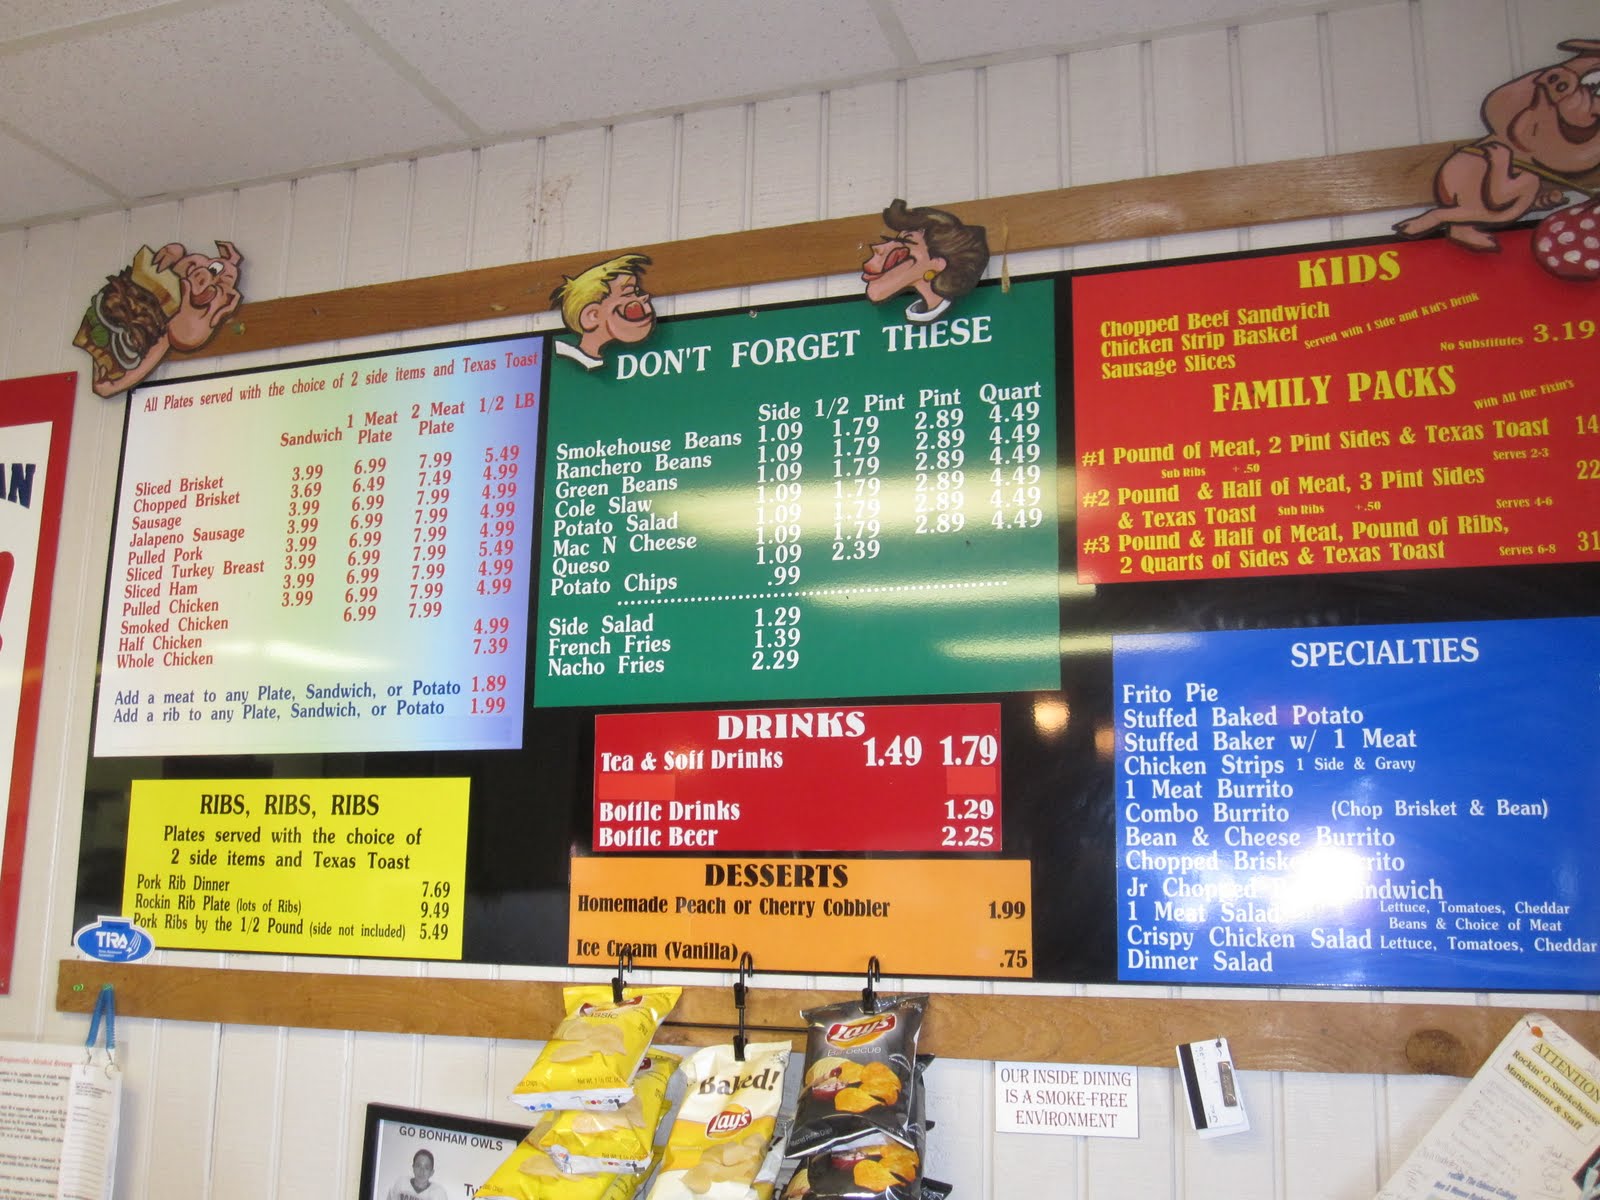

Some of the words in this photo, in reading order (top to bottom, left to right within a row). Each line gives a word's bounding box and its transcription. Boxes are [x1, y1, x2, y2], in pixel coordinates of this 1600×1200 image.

[1297, 249, 1400, 288] KIDS
[1100, 315, 1179, 340] Chopped
[1187, 310, 1229, 329] Beef
[1237, 301, 1330, 325] Sandwich
[1304, 332, 1338, 349] Served
[1341, 326, 1363, 338] with
[1366, 323, 1372, 331] 1
[1374, 317, 1396, 329] Side
[1399, 309, 1418, 322] and
[1421, 302, 1447, 316] Kid's
[1450, 293, 1479, 307] Drink
[1534, 320, 1595, 343] 3.19
[616, 345, 711, 380] DON'T
[731, 330, 860, 368] FORGET
[882, 316, 992, 352] THESE
[1101, 335, 1173, 358] Chicken
[1181, 332, 1225, 353] Strip
[1233, 323, 1297, 346] Basket
[1440, 342, 1455, 351] No
[1458, 337, 1524, 349] Substitutes
[1102, 358, 1176, 379] Sausage
[1185, 354, 1236, 372] Slices
[144, 397, 158, 412] All
[164, 395, 193, 410] Plates
[200, 387, 233, 405] served
[240, 384, 261, 400] with
[268, 382, 285, 397] the
[292, 377, 326, 394] choice
[332, 372, 344, 389] of
[351, 372, 358, 387] 2
[366, 368, 388, 385] side
[395, 367, 426, 381] items
[433, 359, 455, 377] and
[463, 357, 496, 373] Texas
[505, 352, 537, 368] Toast
[979, 381, 1041, 404] Quart
[1213, 375, 1331, 412] FAMILY
[1347, 365, 1456, 402] PACKS
[480, 395, 504, 414] 1/2
[515, 392, 535, 409] LB
[919, 388, 961, 408] Pint
[1473, 397, 1498, 409] With
[1502, 392, 1516, 403] All
[1519, 389, 1537, 399] the
[1540, 380, 1574, 394] Fixin's
[411, 404, 420, 419] 2
[430, 401, 465, 417] Meat
[758, 401, 800, 422] Side
[815, 396, 849, 419] 1/2
[864, 394, 905, 412] Pint
[989, 401, 1040, 423] 4.49
[347, 414, 353, 428] 1
[364, 411, 398, 427] Meat
[418, 420, 454, 436] Plate
[833, 416, 879, 437] 1.79
[915, 408, 964, 430] 2.89
[280, 426, 342, 447] Sandwich
[358, 429, 392, 444] Plate
[758, 421, 803, 443] 1.09
[1082, 449, 1105, 467] #1
[1113, 444, 1174, 464] Pound
[1183, 441, 1201, 459] of
[1210, 438, 1261, 457] Meat,
[1269, 436, 1281, 454] 2
[1290, 432, 1331, 452] Pint
[1339, 430, 1390, 449] Sides
[1399, 426, 1416, 445] &
[1425, 424, 1484, 443] Texas
[1493, 418, 1549, 438] Toast
[485, 445, 519, 463] 5.49
[556, 438, 671, 462] Smokehouse
[685, 432, 742, 449] Beans
[354, 457, 387, 475] 6.99
[419, 451, 452, 469] 7.99
[292, 464, 323, 481] 3.99
[135, 479, 172, 497] Sliced
[179, 476, 224, 492] Brisket
[551, 578, 611, 596] Potato
[624, 573, 677, 594] Chips
[768, 565, 800, 586] .99
[752, 649, 799, 670] 2.29
[1291, 637, 1479, 668] SPECIALTIES
[548, 657, 605, 676] Nacho
[618, 655, 664, 674] Fries
[1123, 684, 1171, 703] Frito
[1186, 682, 1218, 702] Pie
[716, 709, 865, 740] DRINKS
[1124, 707, 1198, 728] Stuffed
[1212, 705, 1278, 726] Baked
[1292, 705, 1364, 725] Potato
[601, 752, 634, 771] Tea
[641, 752, 657, 771] &
[664, 750, 704, 770] Soft
[711, 749, 783, 769] Drinks
[863, 735, 922, 766] 1.49
[939, 735, 998, 765] 1.79
[1124, 756, 1207, 775] Chicken
[1222, 754, 1284, 776] Strips
[1297, 758, 1304, 771] 1
[1314, 757, 1344, 770] Side
[1354, 757, 1365, 770] &
[1375, 756, 1416, 772] Gravy
[200, 794, 250, 817] RIBS,
[264, 794, 316, 818] RIBS,
[331, 794, 379, 816] RIBS
[599, 827, 661, 847] Bottle
[669, 827, 718, 846] Beer
[942, 826, 993, 847] 2.25
[137, 874, 161, 889] Pork
[168, 874, 186, 890] Rib
[193, 875, 230, 891] Dinner
[703, 862, 850, 888] DESSERTS
[422, 881, 450, 898] 7.69
[135, 893, 170, 909] Rockin
[178, 894, 196, 910] Rib
[203, 895, 230, 912] Plate
[262, 899, 272, 912] of
[421, 901, 449, 919] 9.49
[578, 895, 668, 913] Homemade
[676, 896, 726, 914] Peach
[734, 900, 752, 915] or
[759, 898, 815, 918] Cherry
[823, 898, 890, 917] Cobbler
[989, 901, 1025, 919] 1.99
[1381, 901, 1430, 914] Lettuce,
[1439, 901, 1505, 915] Tomatoes,
[1515, 901, 1570, 914] Cheddar
[1128, 949, 1198, 970] Dinner
[1213, 950, 1273, 972] Salad
[1000, 1068, 1029, 1084] OUR
[1033, 1069, 1079, 1085] INSIDE
[1083, 1070, 1132, 1087] DINING
[1533, 1042, 1600, 1102] ATTENTION
[1005, 1089, 1019, 1104] IS
[1022, 1090, 1032, 1104] A
[1036, 1090, 1128, 1108] SMOKE-FREE
[1504, 1063, 1555, 1107] Management
[1553, 1104, 1562, 1115] &
[1550, 1081, 1600, 1127] Smokehouse
[1016, 1109, 1118, 1128] ENVIRONMENT
[399, 1125, 416, 1137] GO
[419, 1128, 468, 1146] BONHAM
[470, 1136, 503, 1151] OWLS
